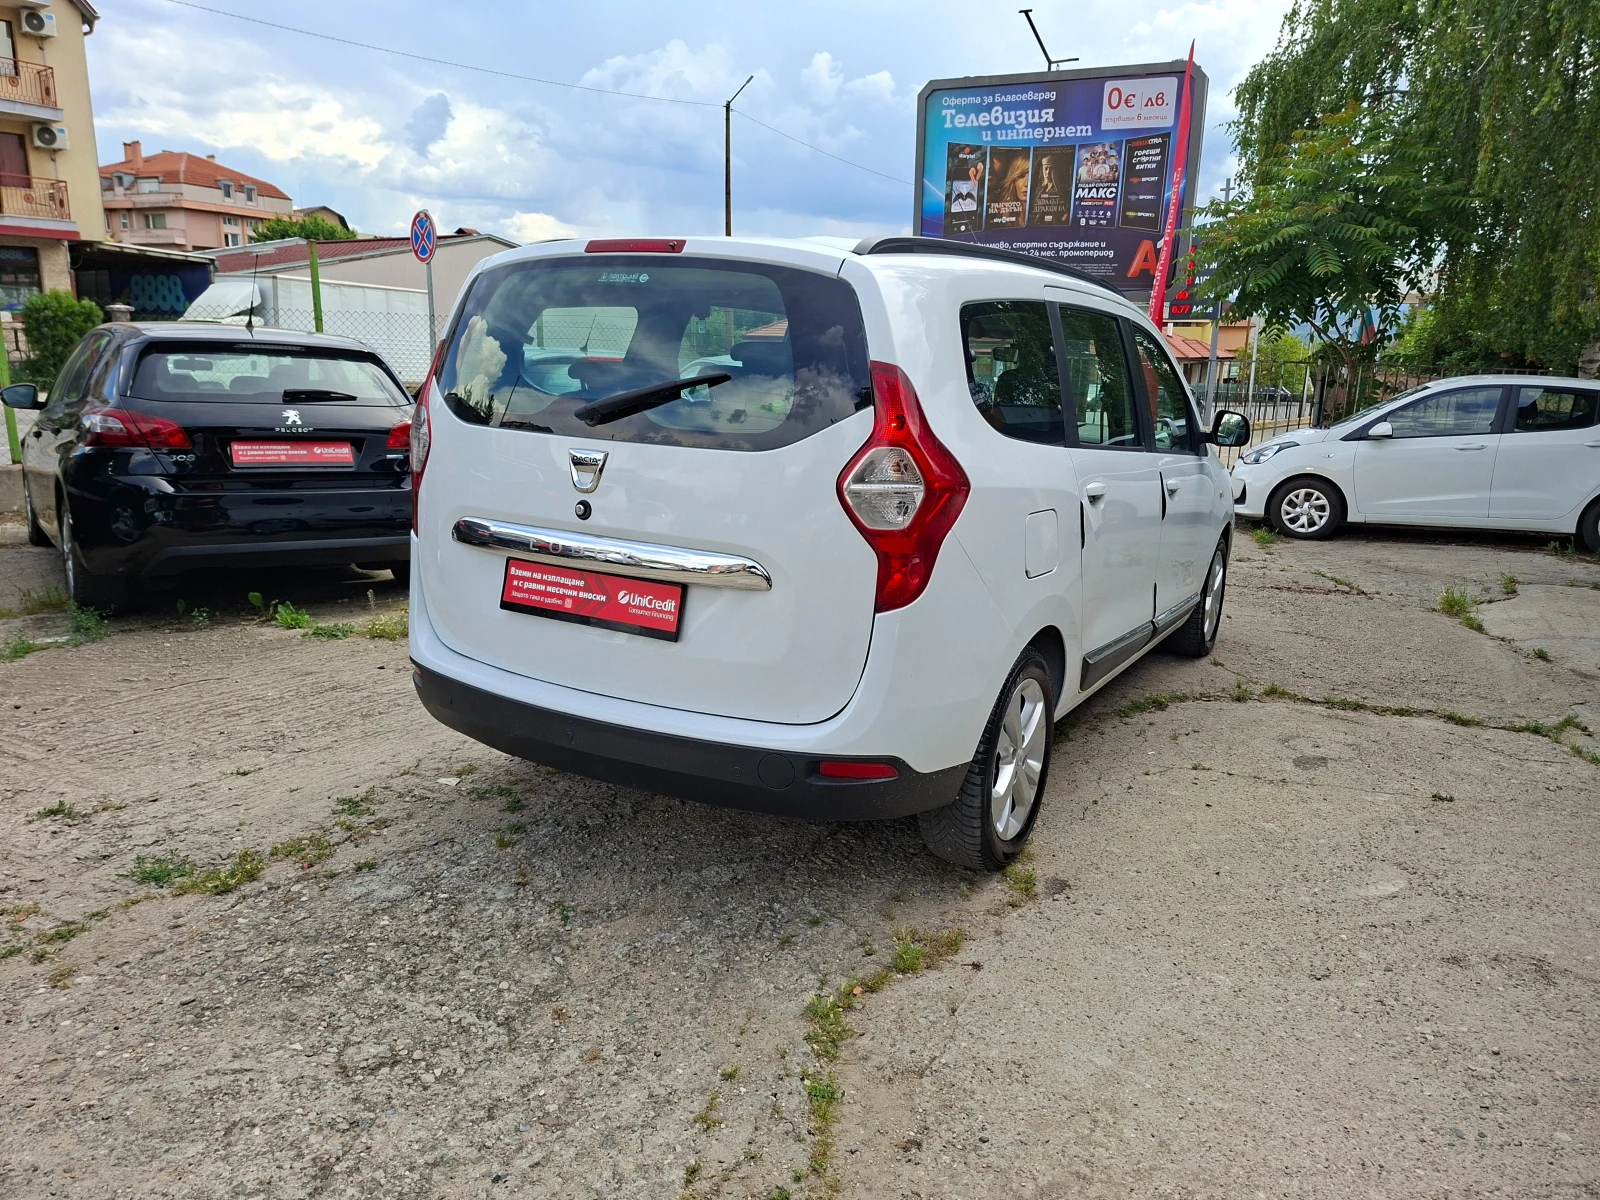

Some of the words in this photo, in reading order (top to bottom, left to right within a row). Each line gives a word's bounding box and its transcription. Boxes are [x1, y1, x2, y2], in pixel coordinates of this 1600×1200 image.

[942, 97, 981, 107] Оферта
[982, 95, 993, 105] за
[994, 91, 1057, 103] Благоевград
[1107, 87, 1136, 110] 0€
[1144, 91, 1169, 107] лв.
[942, 106, 1055, 129] Телевизия
[1137, 113, 1142, 121] 6
[982, 130, 992, 141] и
[997, 125, 1092, 142] интернет
[1134, 148, 1160, 156] ГОРЕЩИ
[1075, 187, 1117, 199] МАКС
[1012, 241, 1048, 250] спортно
[1048, 240, 1100, 250] съдържание
[1059, 250, 1114, 258] промопериод
[1171, 305, 1190, 314] 0.77
[571, 455, 599, 464] DACIA
[510, 567, 532, 578] Вземи
[532, 571, 541, 580] на
[542, 573, 585, 587] изплащане
[523, 581, 545, 592] равни
[546, 585, 578, 597] месечни
[578, 590, 607, 602] вноски
[630, 592, 676, 612] UniCredit
[628, 606, 651, 616] Consumer
[651, 610, 674, 622] Financing
